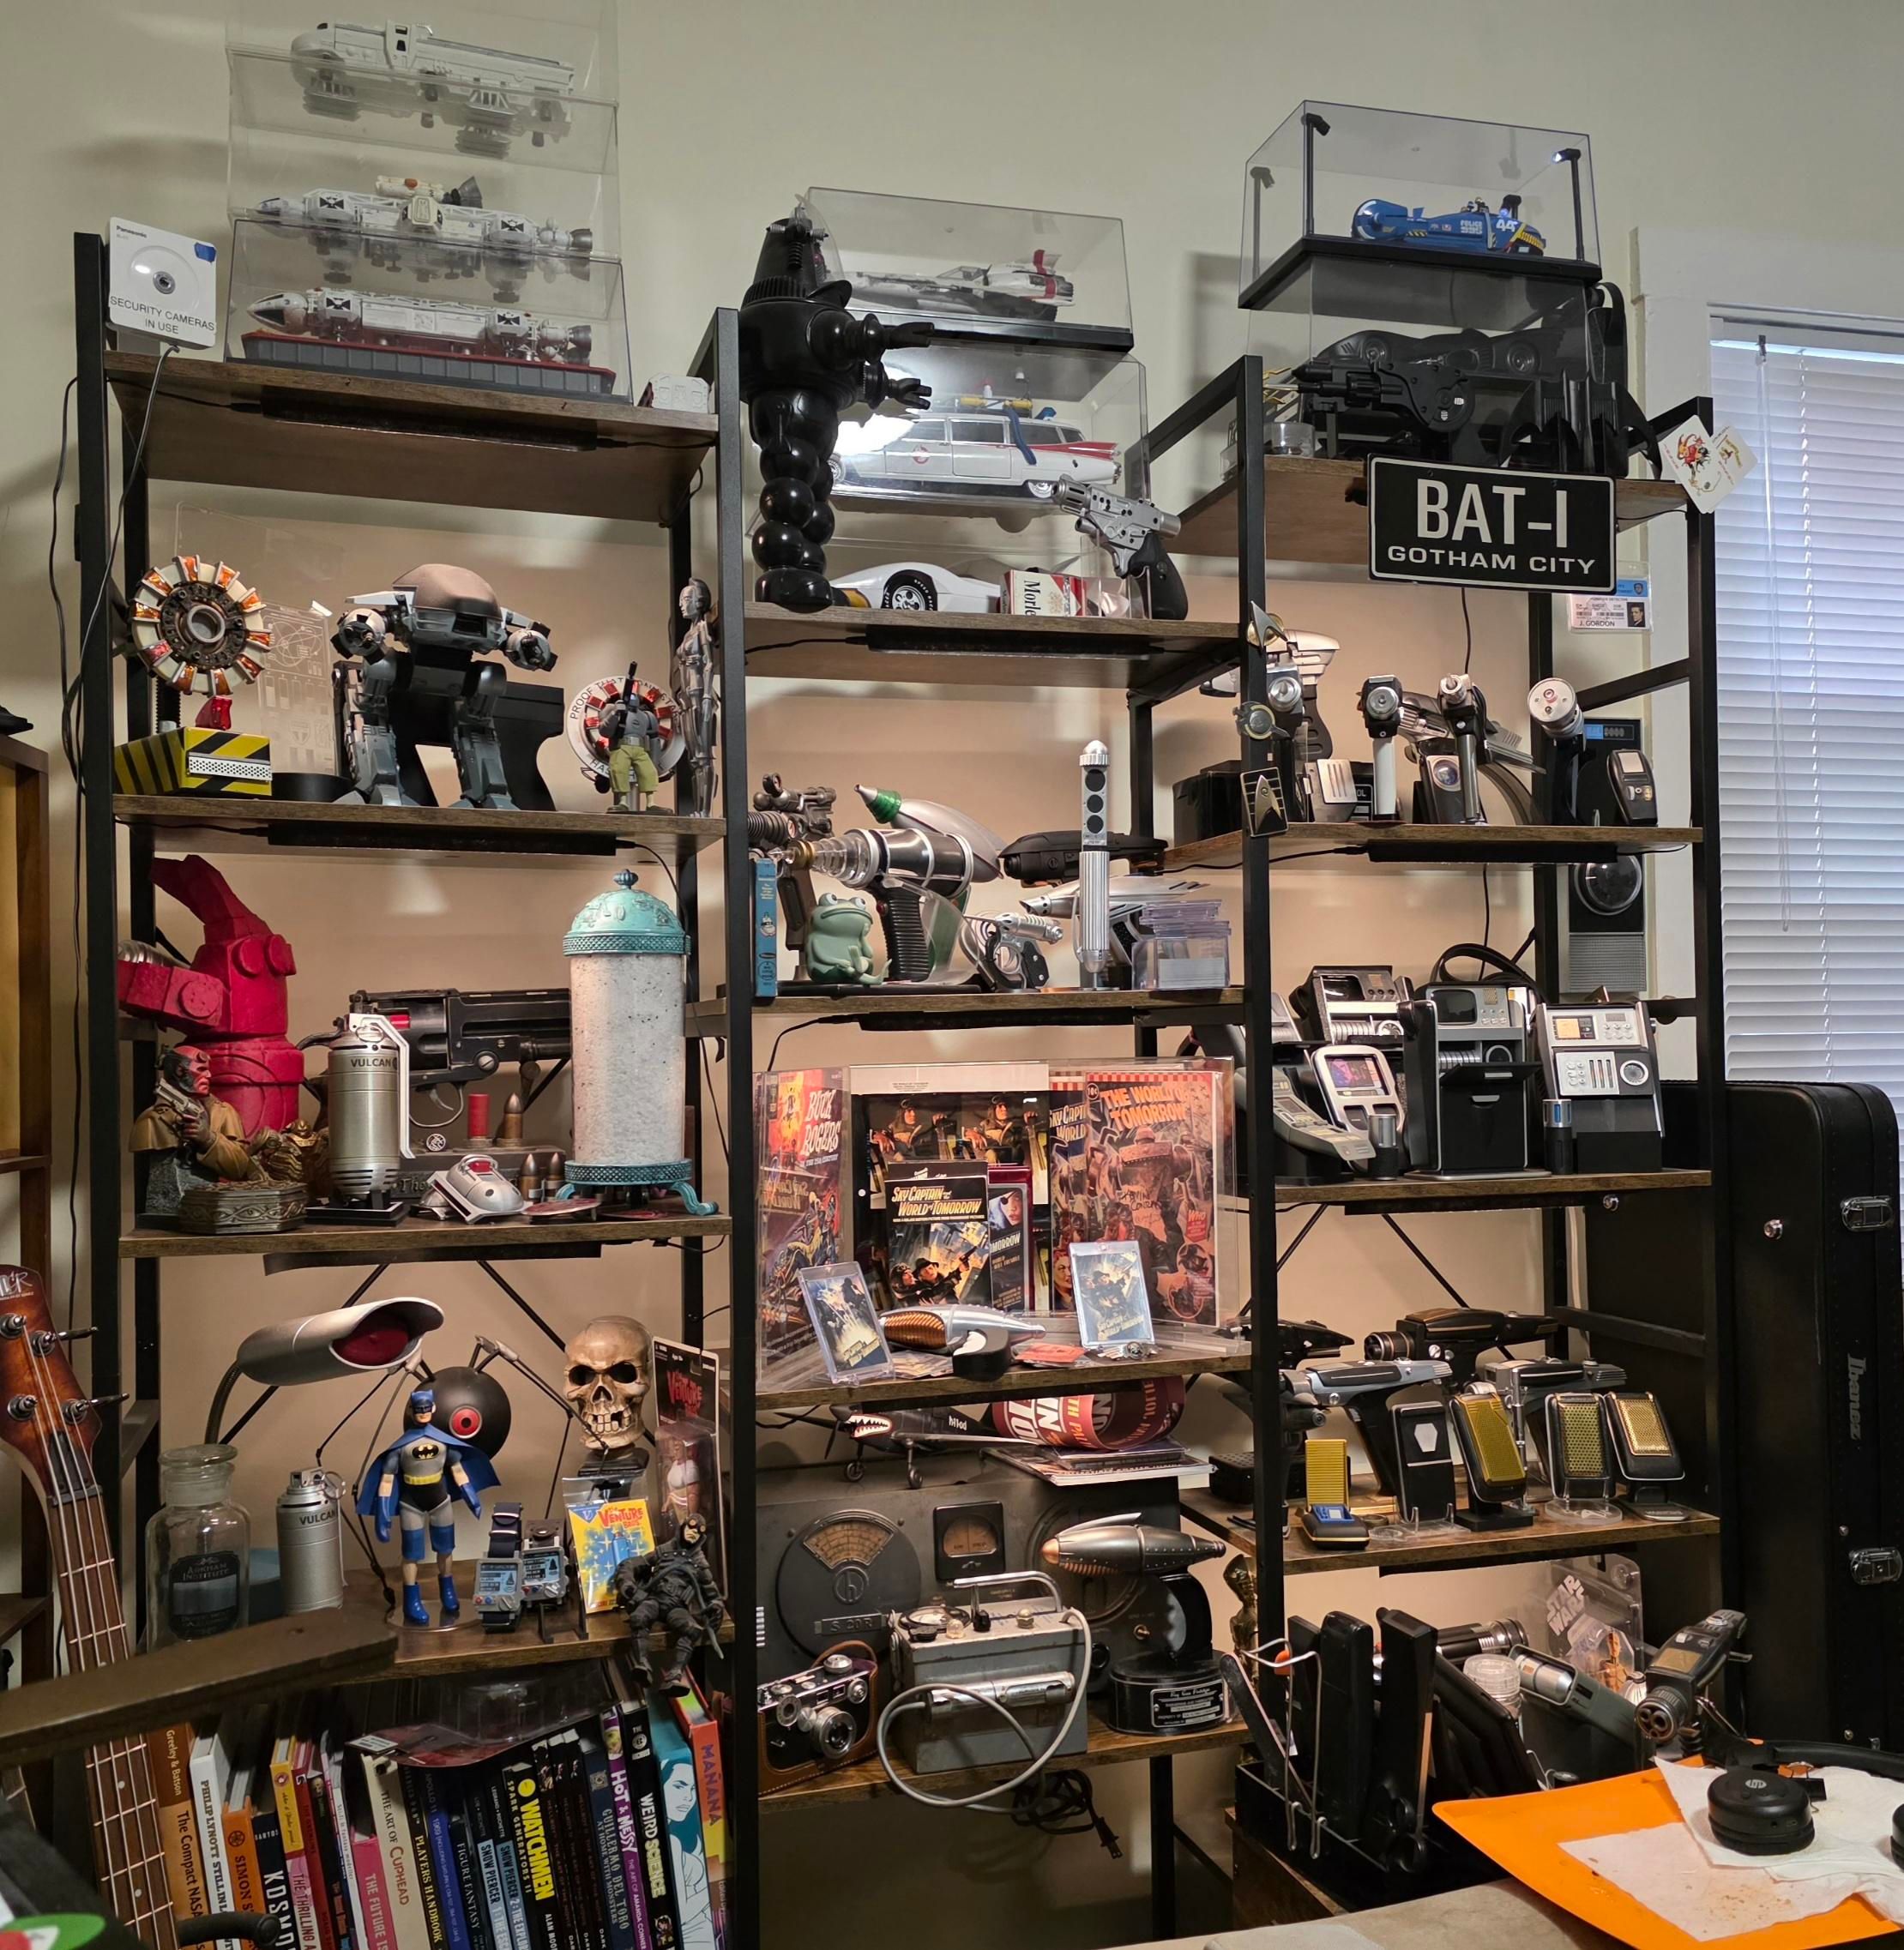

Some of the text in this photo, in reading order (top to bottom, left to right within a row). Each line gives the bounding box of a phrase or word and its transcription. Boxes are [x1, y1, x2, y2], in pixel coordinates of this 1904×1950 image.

[1496, 220, 1516, 232] 44
[111, 296, 214, 331] SECURITY CAMERAS
[145, 319, 179, 334] IN USE
[1388, 545, 1595, 575] GOTHAM CITY
[569, 687, 594, 720] PROOF
[351, 1057, 391, 1068] VULCAN
[805, 1089, 836, 1122] BUCK
[1100, 1088, 1129, 1109] THE
[1130, 1085, 1173, 1104] WORLD
[1110, 1102, 1187, 1132] TOMORROW
[799, 1120, 841, 1157] ROGERS
[892, 1186, 944, 1202] SKY CAPTAIN
[899, 1201, 928, 1216] WORLD
[931, 1201, 982, 1216] TOMORROW
[1188, 1210, 1207, 1221] WHO
[1847, 1352, 1866, 1441] Ibanez
[599, 1508, 643, 1527] VENTURE
[1546, 1575, 1582, 1622] STAR
[1549, 1586, 1585, 1636] WARS
[166, 1730, 178, 1759] Greeley
[172, 1769, 184, 1796] Batson
[201, 1780, 213, 1816] PHILIP
[701, 1744, 723, 1827] MAÑANA
[177, 1811, 189, 1833] The
[381, 1791, 398, 1844] THE ART OF
[618, 1805, 630, 1815] &
[206, 1817, 220, 1858] LYNOTT
[496, 1813, 505, 1839] ROCHETTE
[507, 1780, 532, 1893] SPARK GENERATORS II
[179, 1835, 199, 1885] Compact
[480, 1845, 493, 1869] SNOW
[500, 1845, 514, 1868] SNOW
[520, 1797, 555, 1901] WATCHMEN
[639, 1792, 666, 1899] WEIRD SCIENCE
[213, 1862, 224, 1892] STILL
[235, 1856, 251, 1899] SIMON
[292, 1874, 305, 1890] THE
[344, 1854, 353, 1880] modeller
[596, 1821, 618, 1924] AT HOME WITH MONSTERS
[601, 1809, 630, 1929] GUILLERMO DEL TORO
[218, 1892, 226, 1904] IN
[365, 1874, 379, 1895] THE
[414, 1835, 443, 1943] PLAYERS HANDBOOK
[455, 1843, 479, 1929] FIGURE FANTASY
[485, 1871, 500, 1905] PIERCER
[505, 1869, 518, 1899] PIERCER
[630, 1884, 637, 1893] OF
[295, 1893, 315, 1941] THRILLING
[368, 1898, 386, 1938] FUTURE
[511, 1910, 525, 1922] THE
[633, 1893, 642, 1922] AMANDA
[495, 1918, 506, 1934] THE
[545, 1914, 558, 1950] ALAN MOO
[637, 1923, 647, 1950] CONNER
